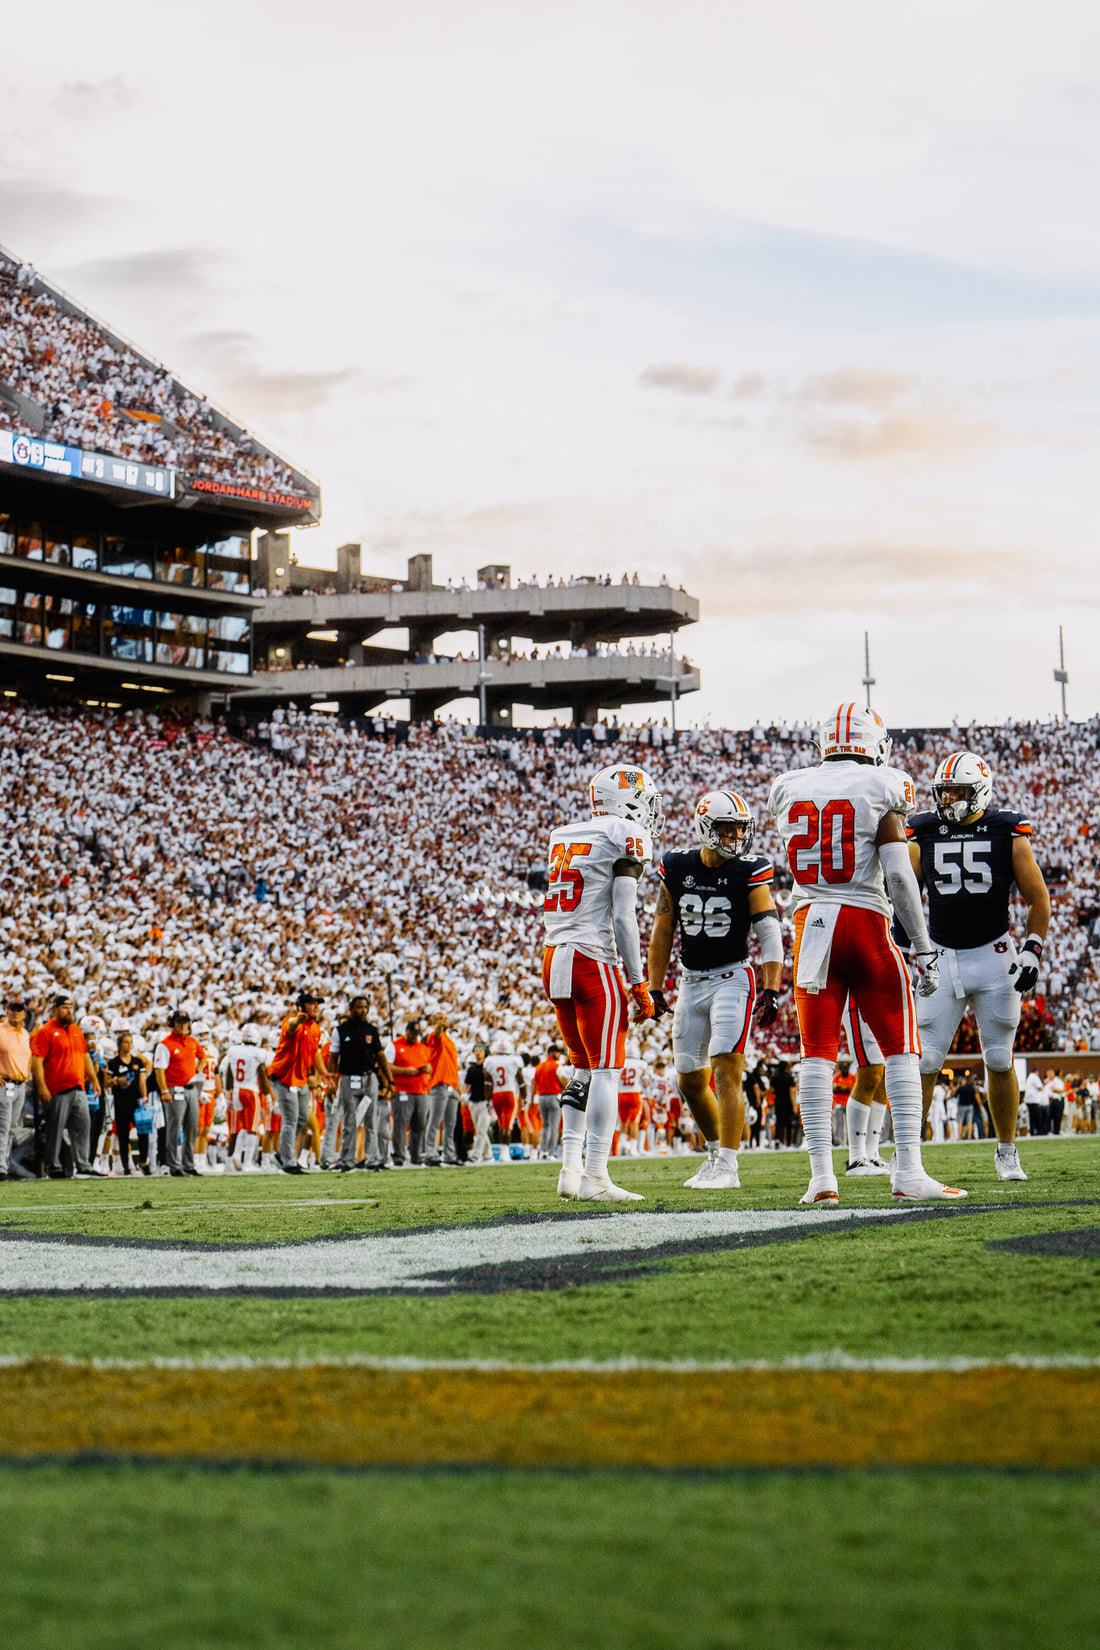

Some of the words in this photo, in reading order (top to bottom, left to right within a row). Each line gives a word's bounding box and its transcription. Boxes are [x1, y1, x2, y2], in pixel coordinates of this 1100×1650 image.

[267, 492, 312, 509] STADIUM
[854, 746, 866, 755] BAR
[625, 837, 644, 857] 25
[787, 799, 856, 885] 20
[543, 842, 592, 913] 25
[934, 840, 993, 896] 55
[236, 1058, 246, 1082] 6
[496, 1066, 506, 1087] 3
[620, 1067, 636, 1086] 42
